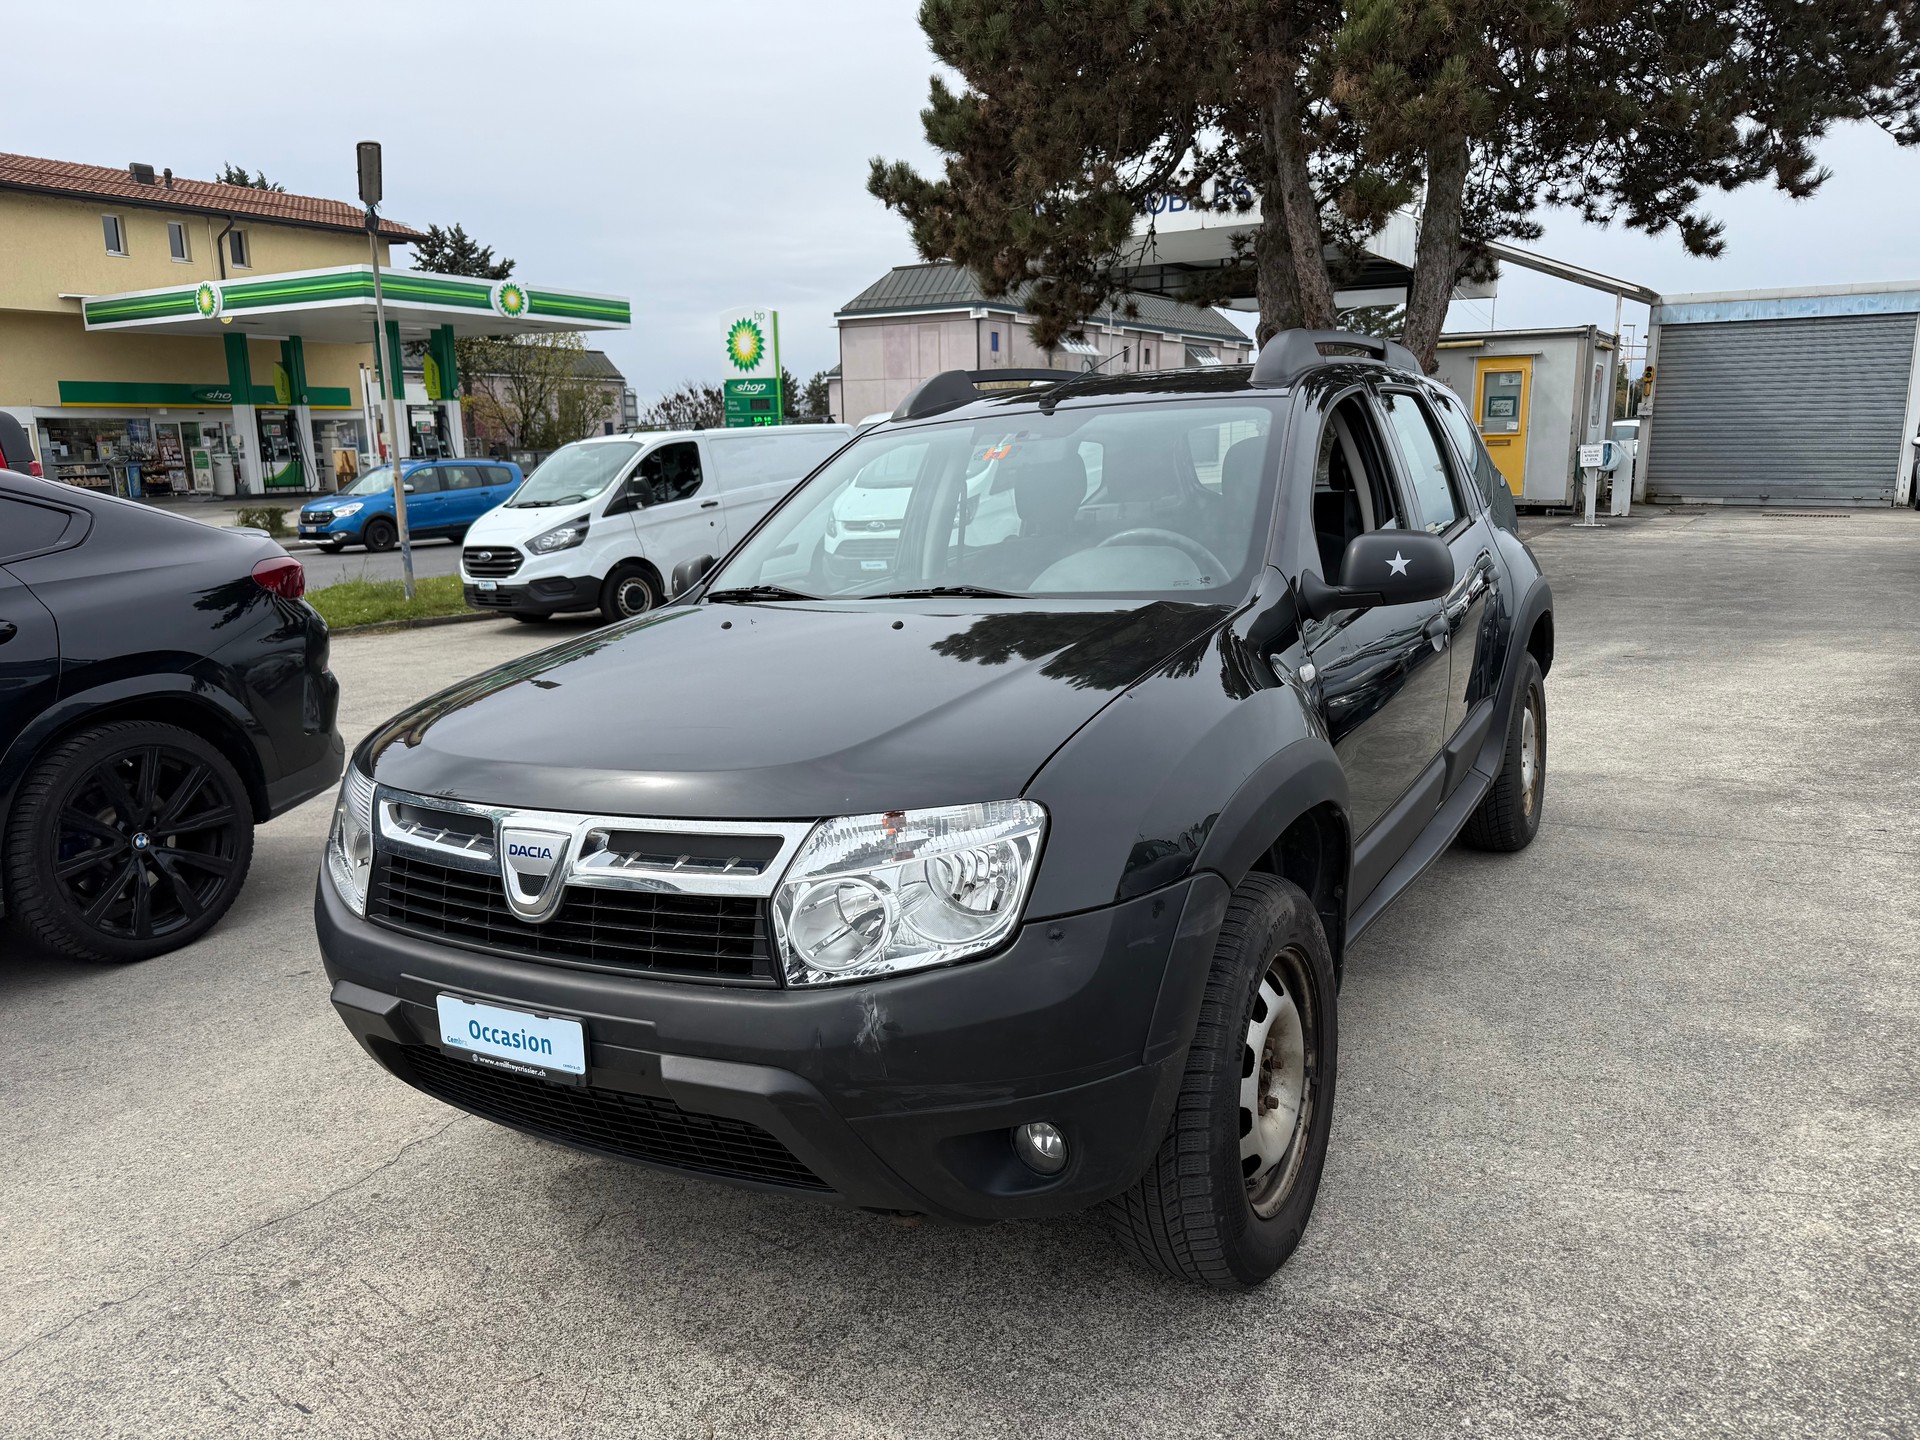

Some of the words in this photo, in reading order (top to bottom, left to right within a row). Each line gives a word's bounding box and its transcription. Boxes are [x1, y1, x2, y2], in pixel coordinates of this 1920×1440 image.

[754, 310, 766, 322] bp
[736, 381, 767, 395] shop
[205, 390, 232, 402] sho
[509, 843, 553, 860] DACIA
[468, 1019, 553, 1056] Occasion
